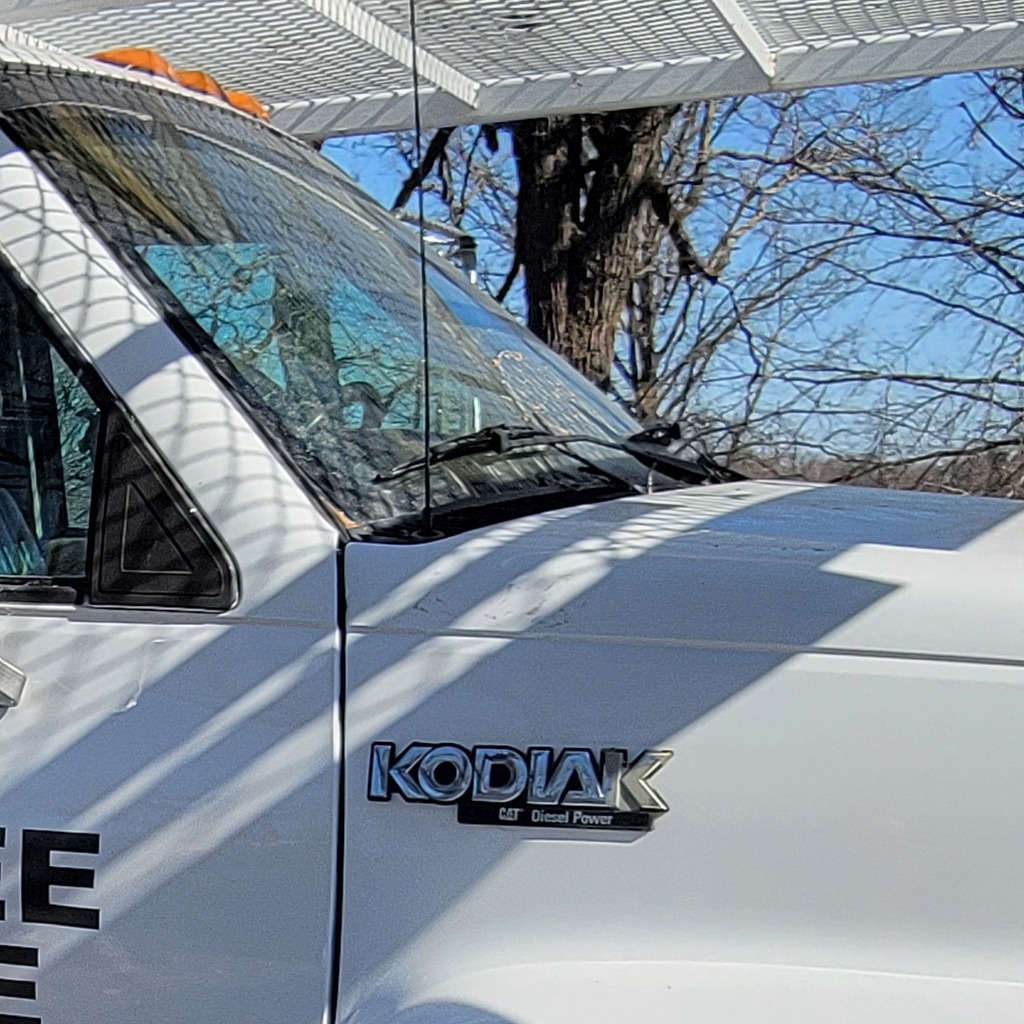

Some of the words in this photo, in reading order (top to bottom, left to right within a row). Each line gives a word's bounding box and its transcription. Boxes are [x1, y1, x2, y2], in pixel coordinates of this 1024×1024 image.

[367, 741, 674, 812] KODIAK
[499, 807, 521, 821] CAT
[531, 809, 569, 825] Diesel
[573, 811, 613, 827] Power
